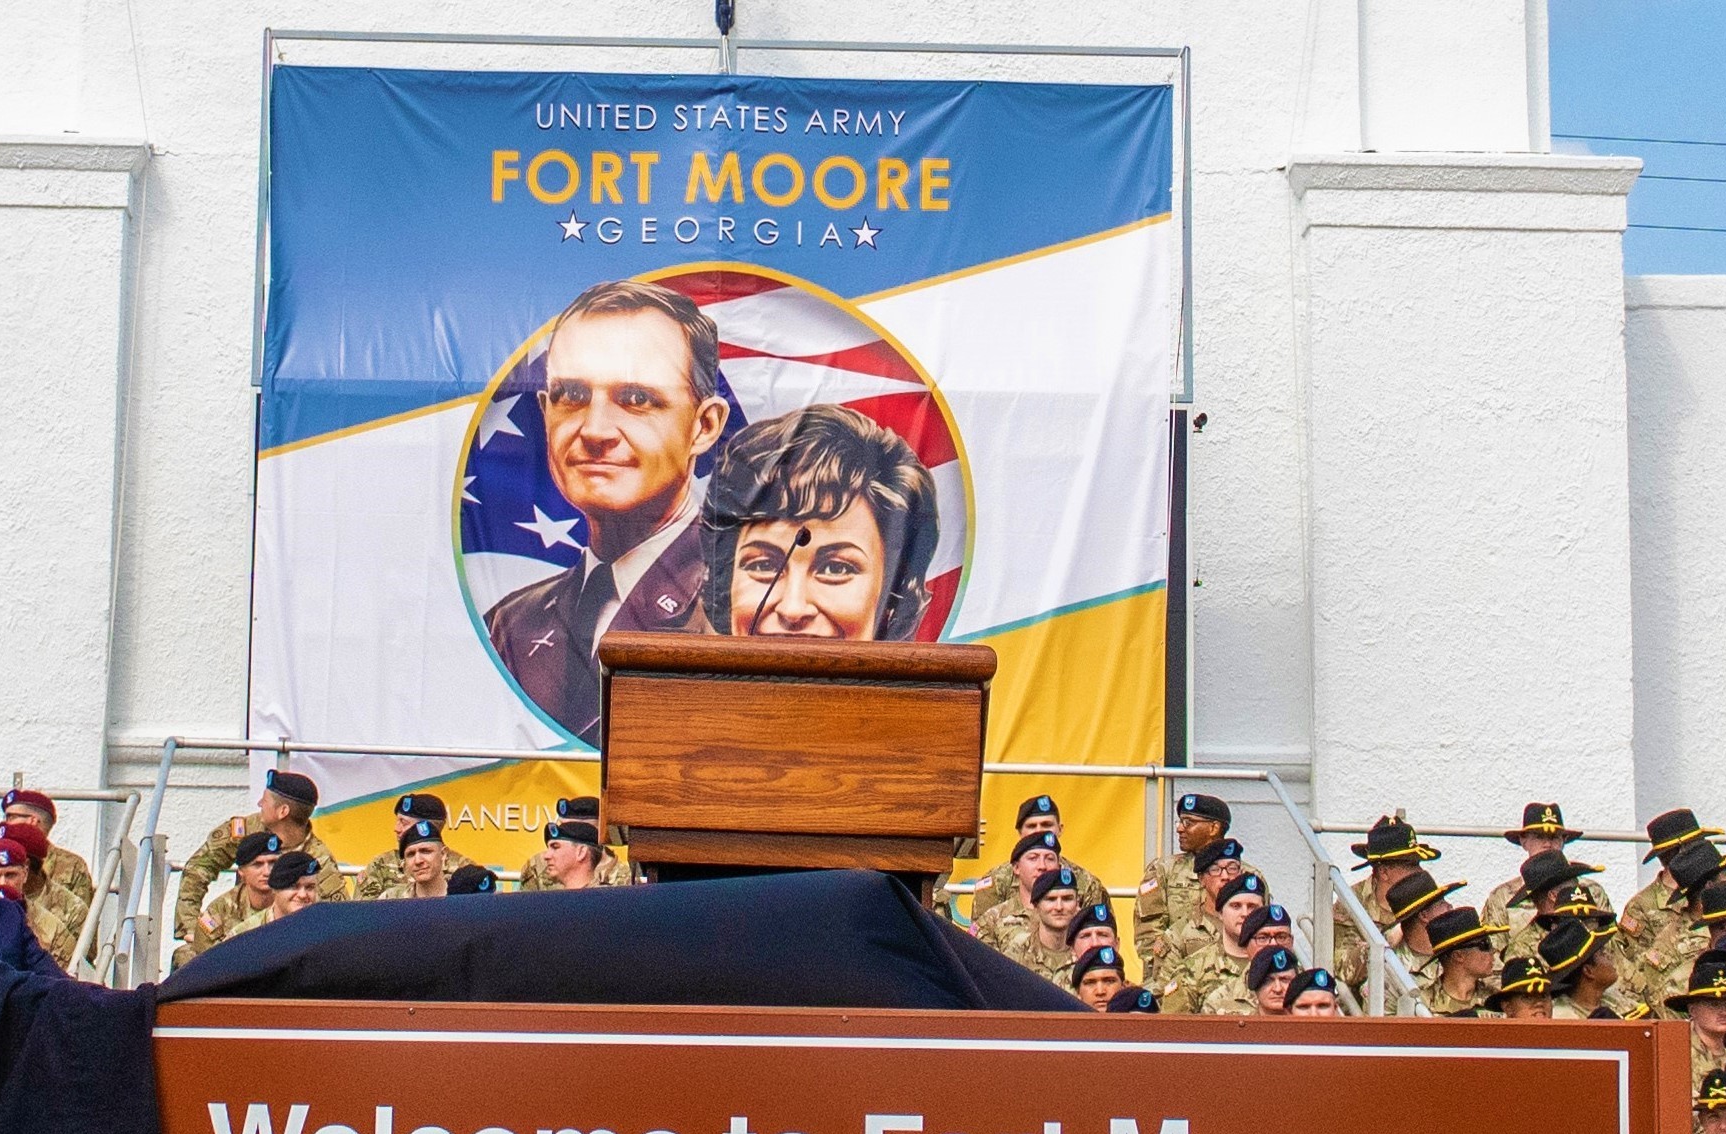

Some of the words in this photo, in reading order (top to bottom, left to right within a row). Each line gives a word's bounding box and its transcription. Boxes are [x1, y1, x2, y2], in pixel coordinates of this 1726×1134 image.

[535, 103, 658, 132] UNITED
[673, 105, 787, 134] STATES
[803, 108, 906, 136] ARMY
[491, 149, 660, 205] FORT
[684, 152, 951, 212] MOORE
[596, 217, 843, 248] GEORGIA
